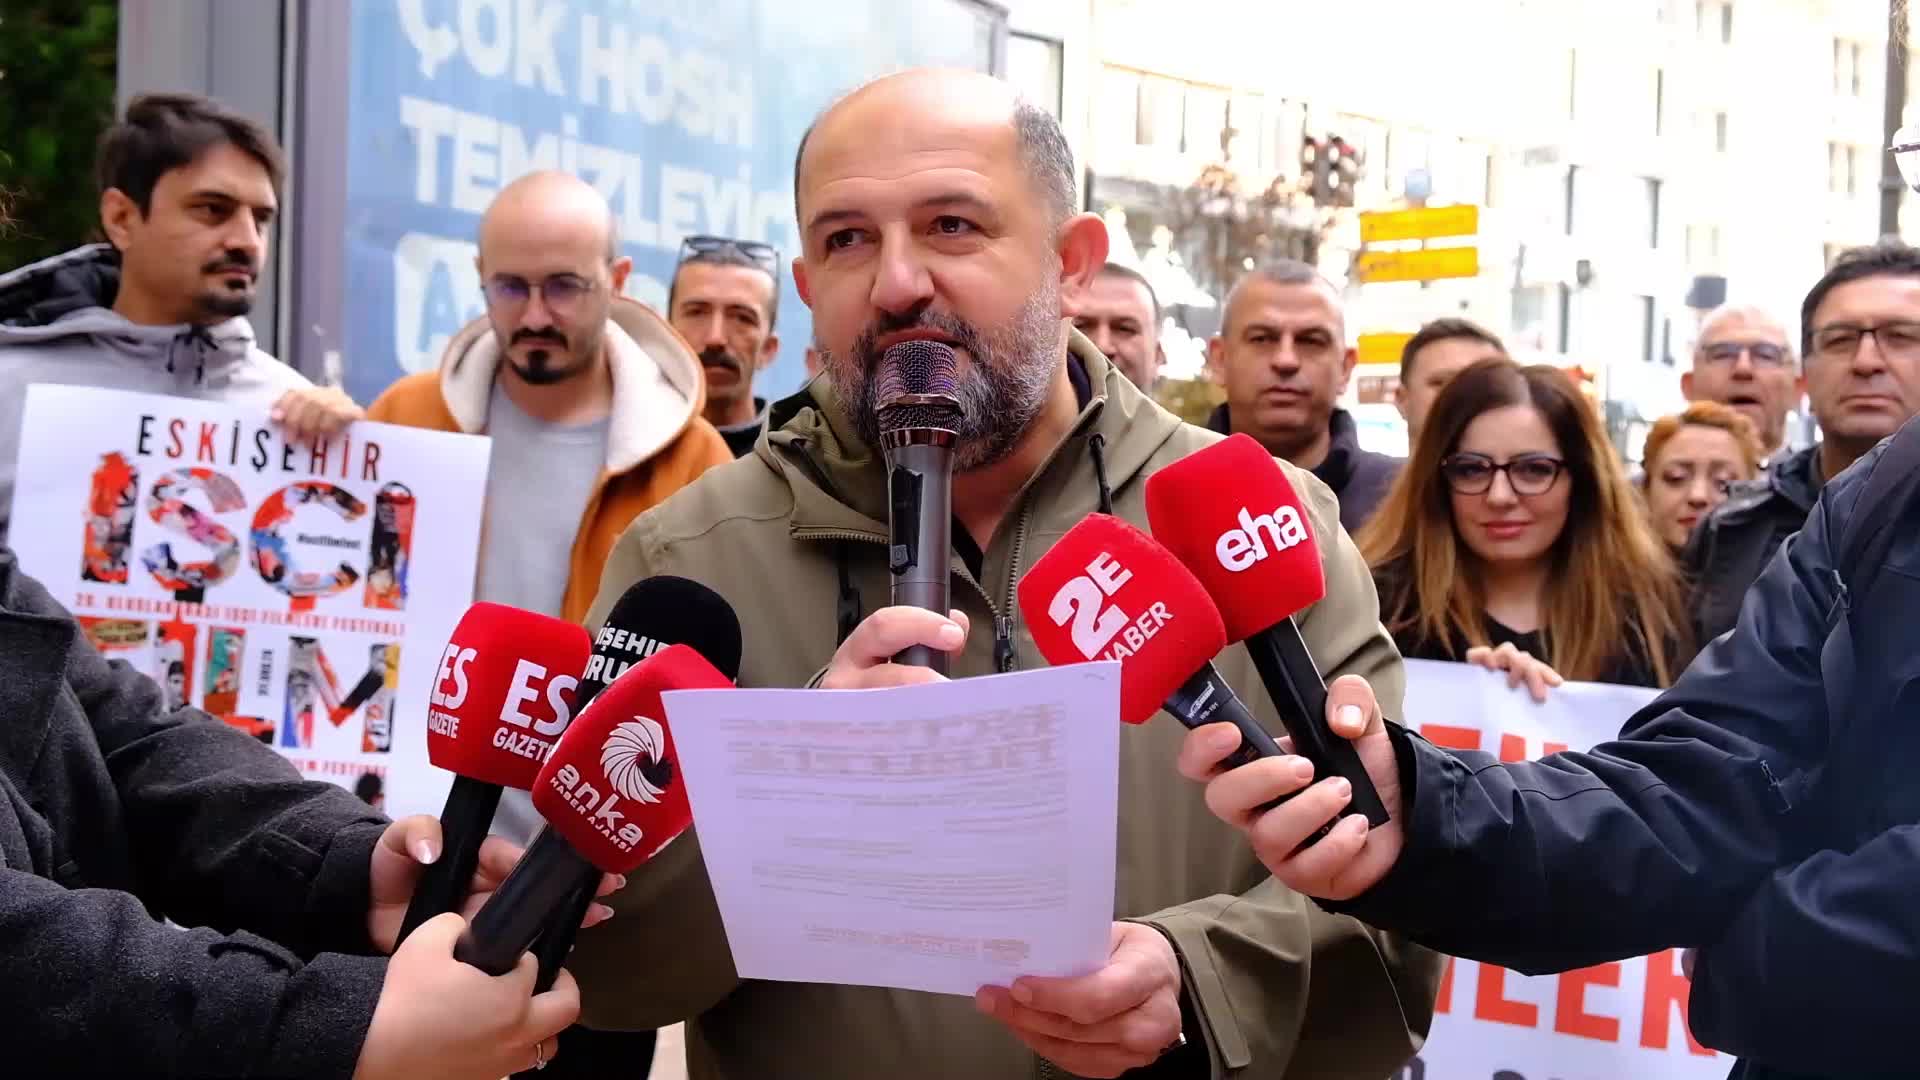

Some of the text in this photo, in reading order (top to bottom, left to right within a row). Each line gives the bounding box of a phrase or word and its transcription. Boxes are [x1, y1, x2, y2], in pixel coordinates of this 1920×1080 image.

[397, 0, 757, 150] ÇOK HOSH
[1215, 504, 1309, 573] eha
[430, 642, 479, 710] ES
[499, 658, 579, 736] ES
[429, 708, 460, 739] GAZETE
[550, 777, 632, 853] HABER AJANSI
[557, 764, 643, 847] anka
